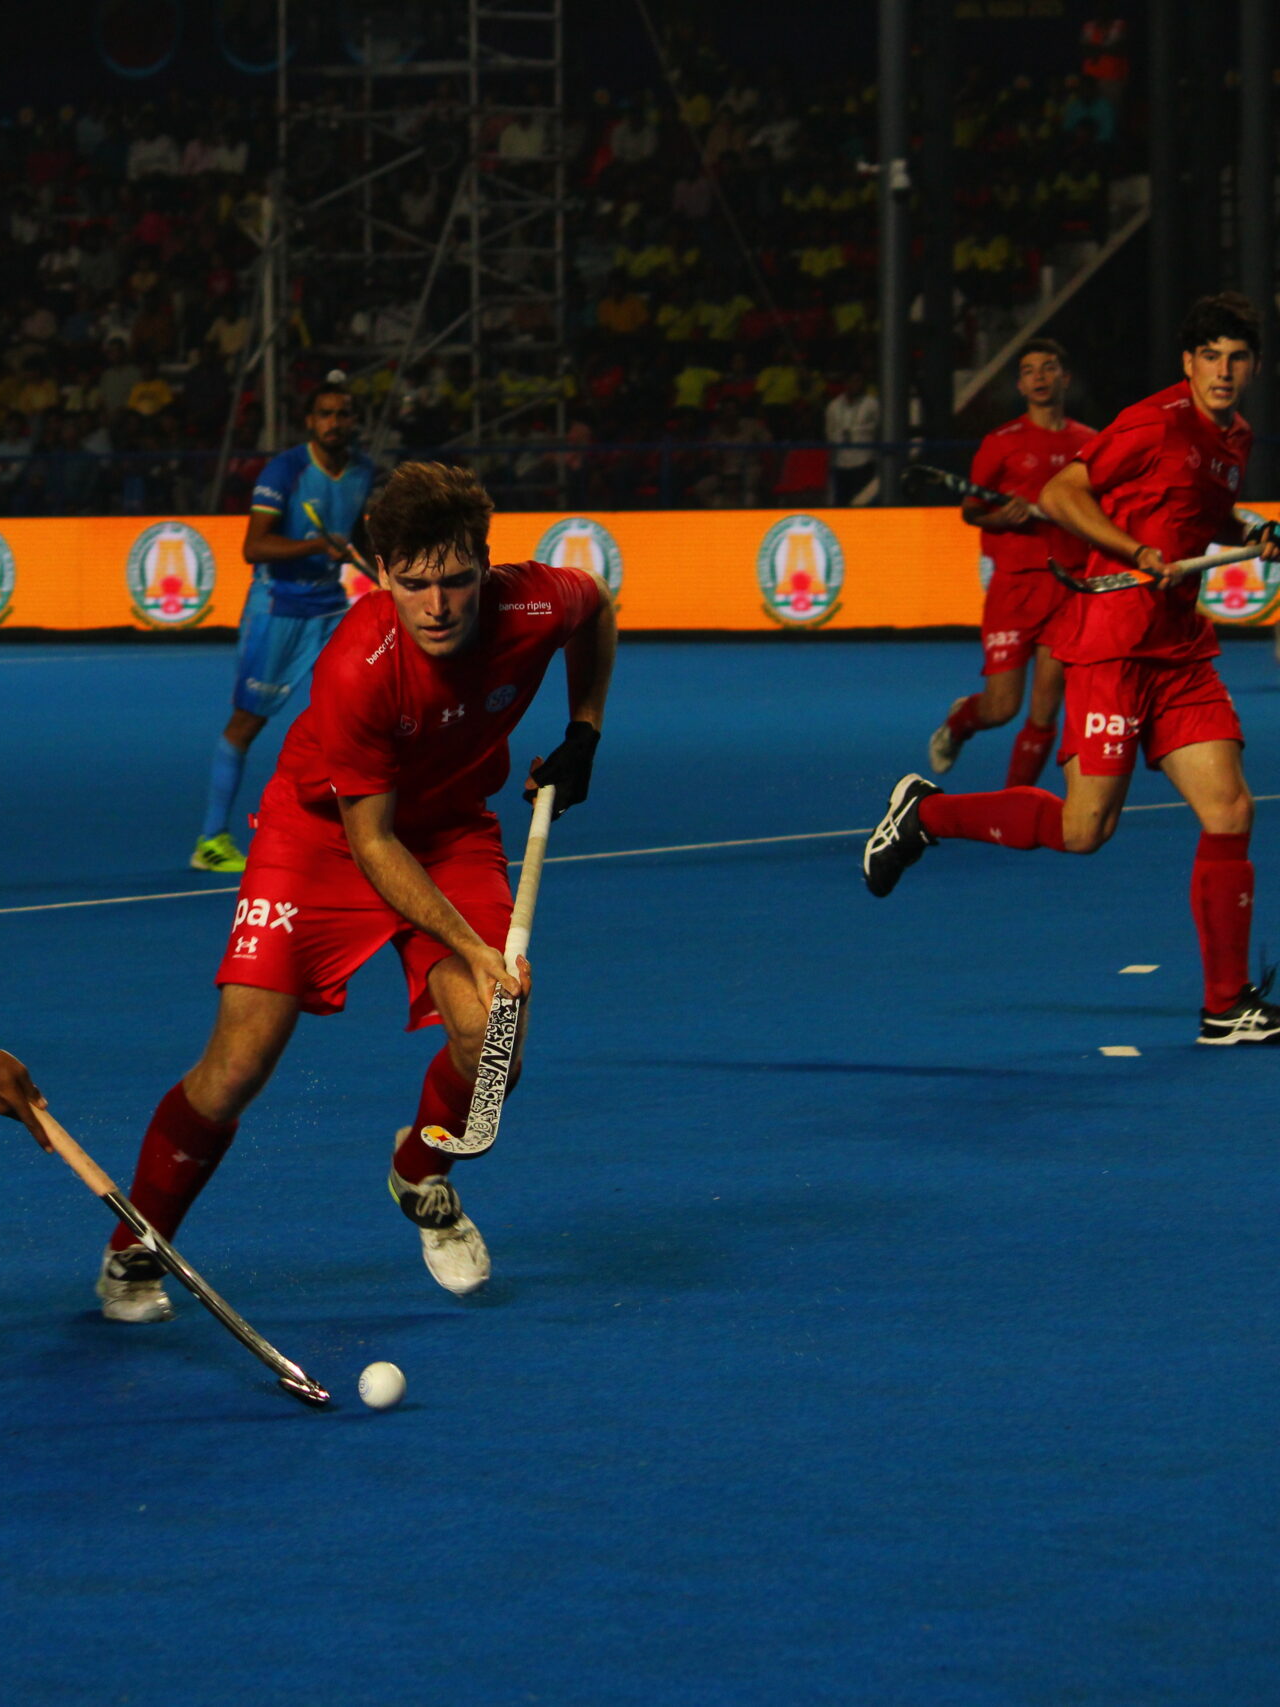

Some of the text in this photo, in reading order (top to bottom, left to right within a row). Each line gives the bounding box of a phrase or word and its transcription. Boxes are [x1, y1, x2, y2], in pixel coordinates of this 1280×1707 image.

[498, 601, 551, 611] banco ripley
[366, 643, 387, 665] banco
[232, 897, 300, 935] pax
